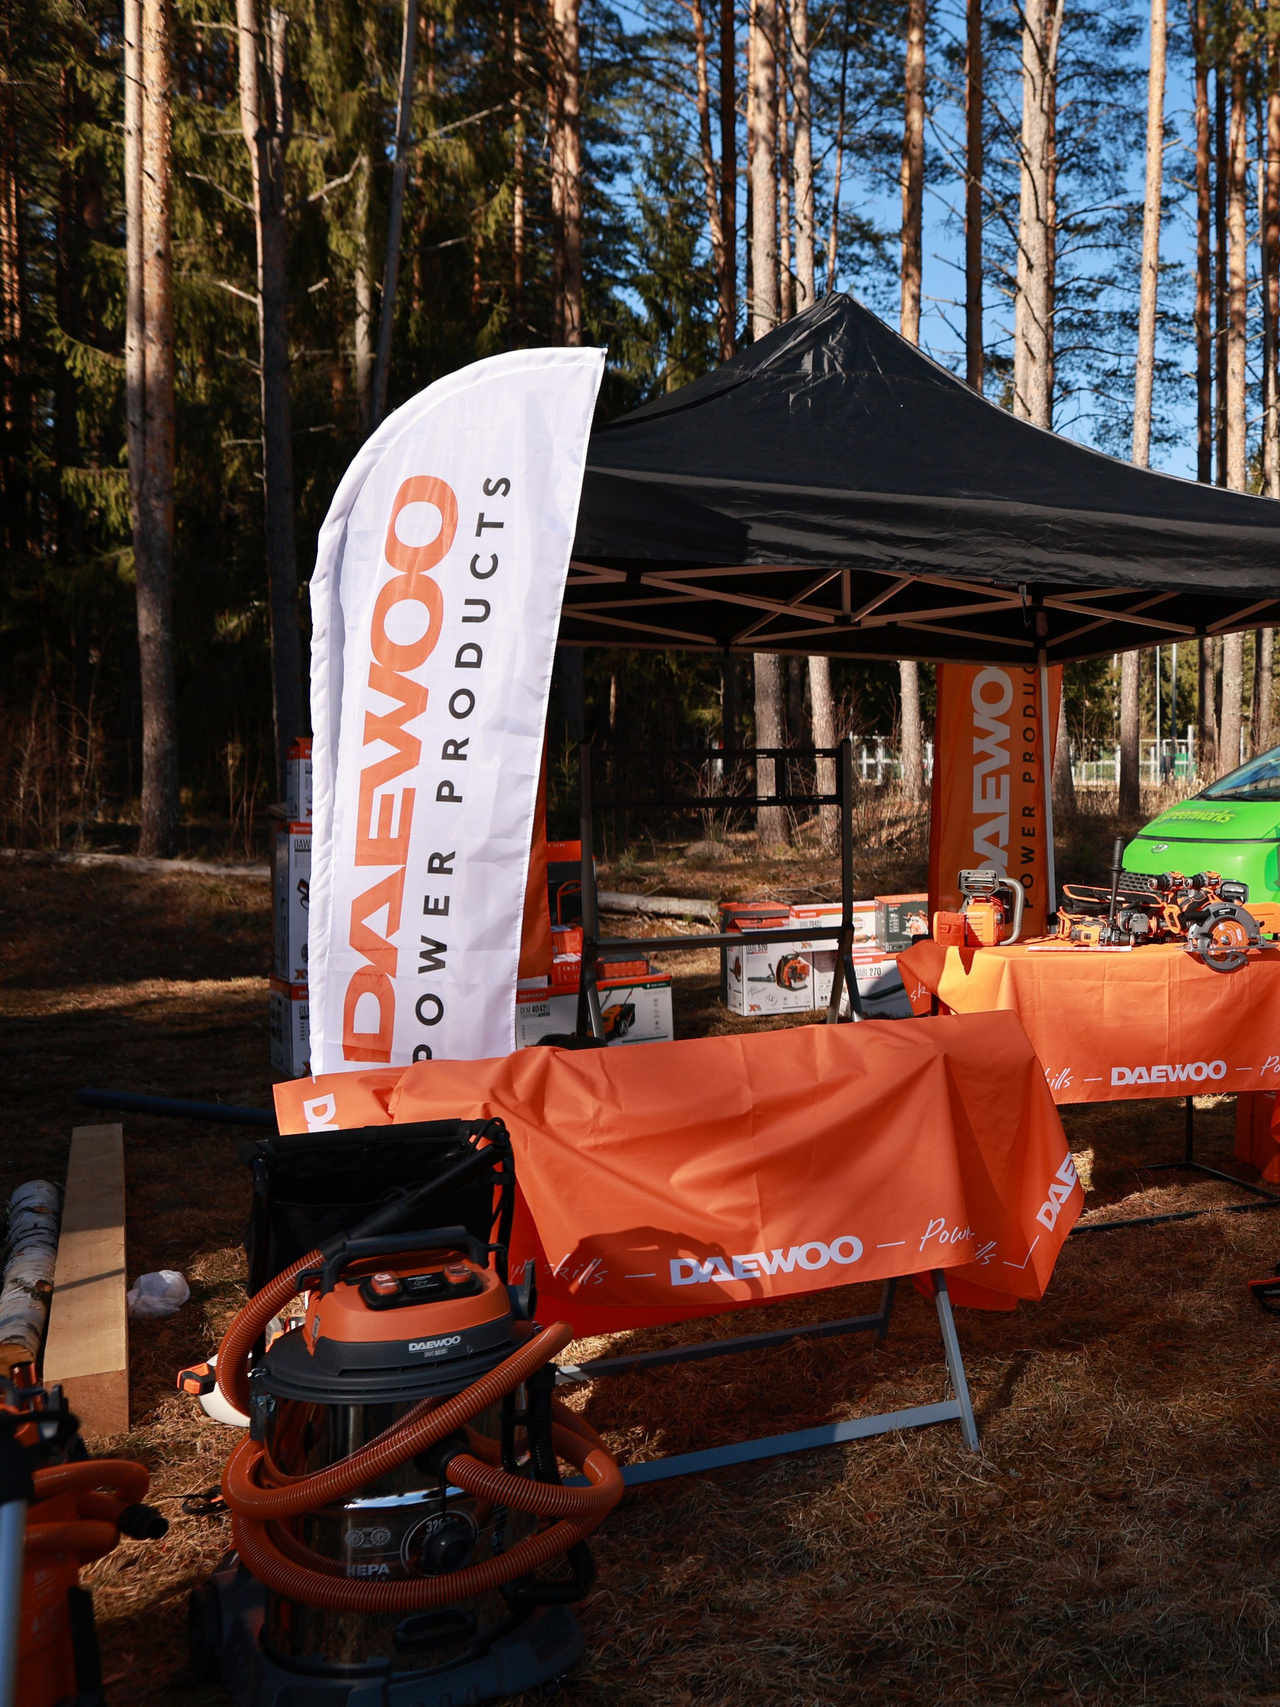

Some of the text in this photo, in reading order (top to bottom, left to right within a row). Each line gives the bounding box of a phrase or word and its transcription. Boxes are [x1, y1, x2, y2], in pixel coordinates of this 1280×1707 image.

[342, 475, 458, 1063] DAEWOO
[412, 476, 511, 1063] POWER PRODUCTS
[870, 967, 881, 977] 270
[1111, 1060, 1227, 1086] DAEWOO
[669, 1235, 864, 1286] DAEWOO
[409, 1335, 461, 1351] DAEWOO
